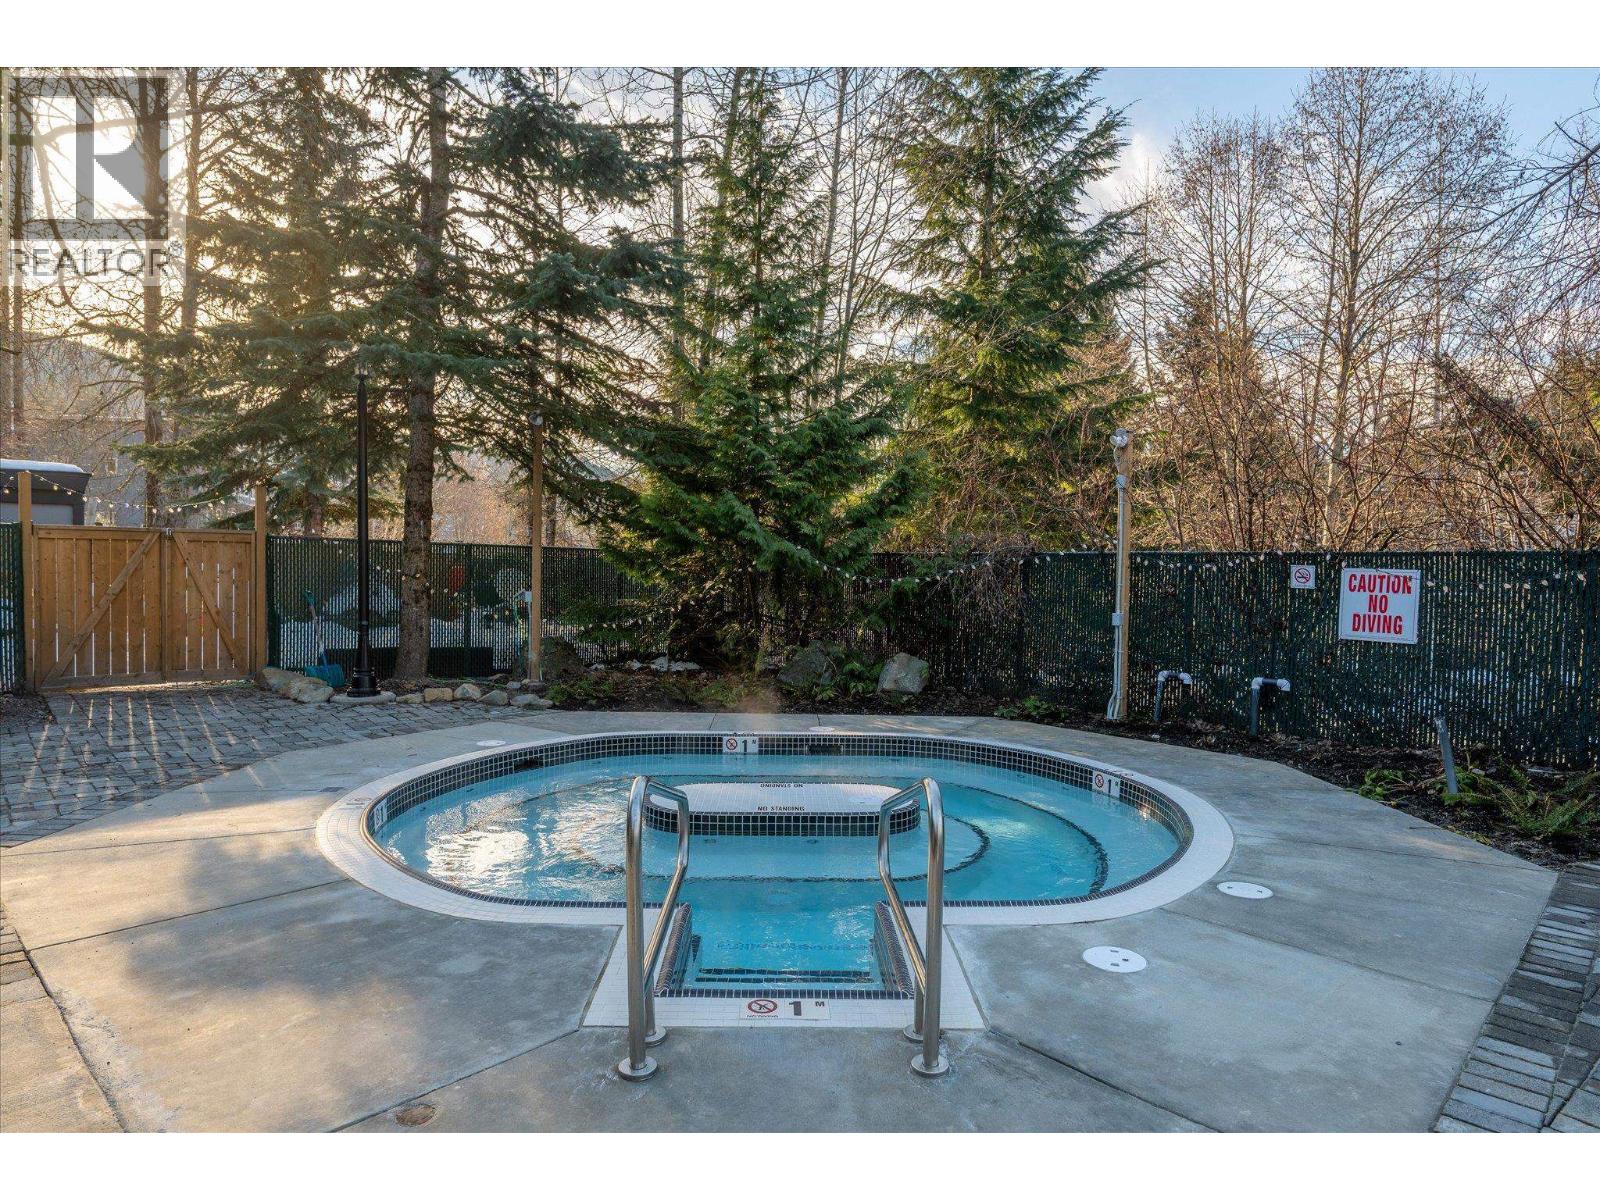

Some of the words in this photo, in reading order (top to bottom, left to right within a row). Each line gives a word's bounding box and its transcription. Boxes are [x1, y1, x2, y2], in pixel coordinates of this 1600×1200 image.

[1348, 573, 1412, 594] CAUTION
[1368, 594, 1388, 613] NO
[1352, 613, 1403, 635] DIVING
[741, 739, 748, 753] 1
[788, 1000, 803, 1017] 1
